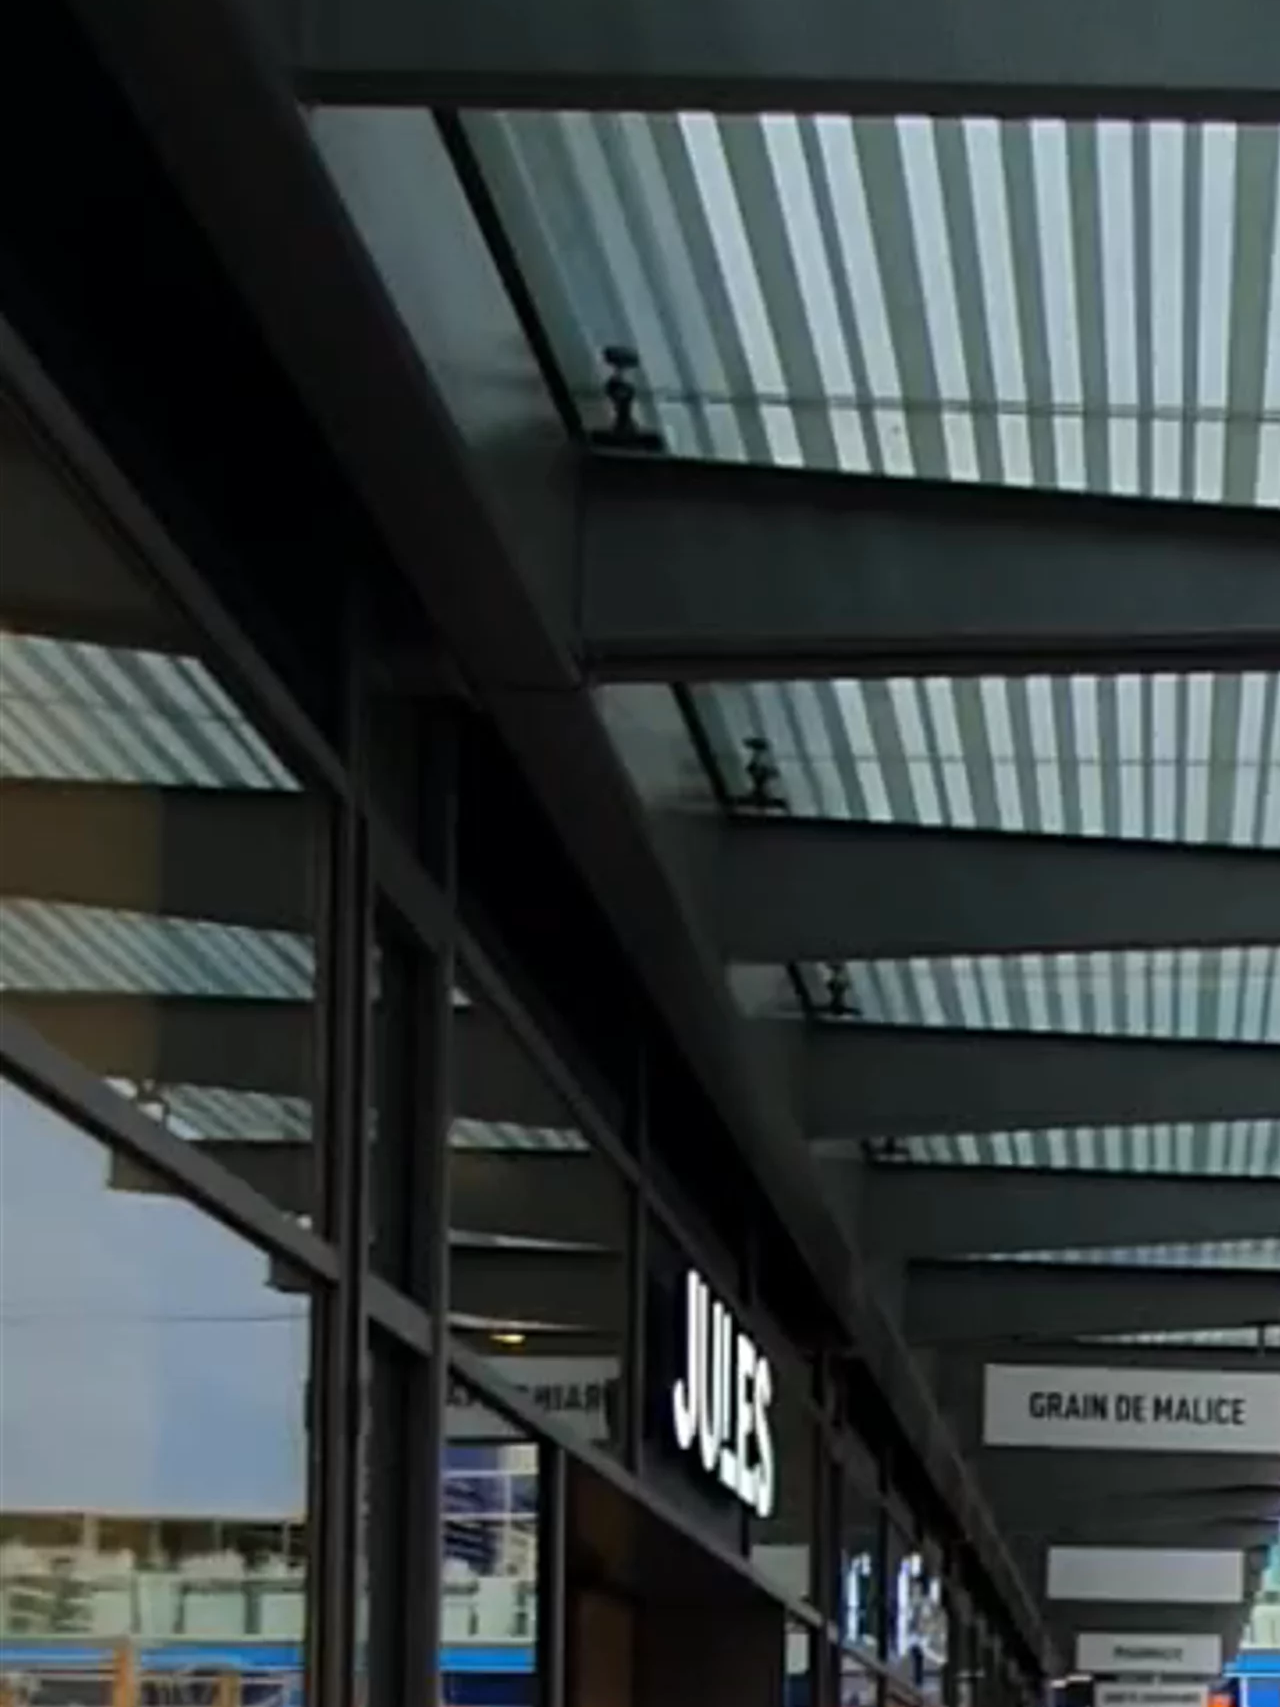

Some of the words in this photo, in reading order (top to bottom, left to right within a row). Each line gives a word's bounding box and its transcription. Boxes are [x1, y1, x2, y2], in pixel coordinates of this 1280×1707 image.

[674, 1270, 774, 1517] JULES
[1029, 1392, 1109, 1421] GRAIN
[1115, 1394, 1148, 1423] DE
[1153, 1395, 1247, 1426] MALICE
